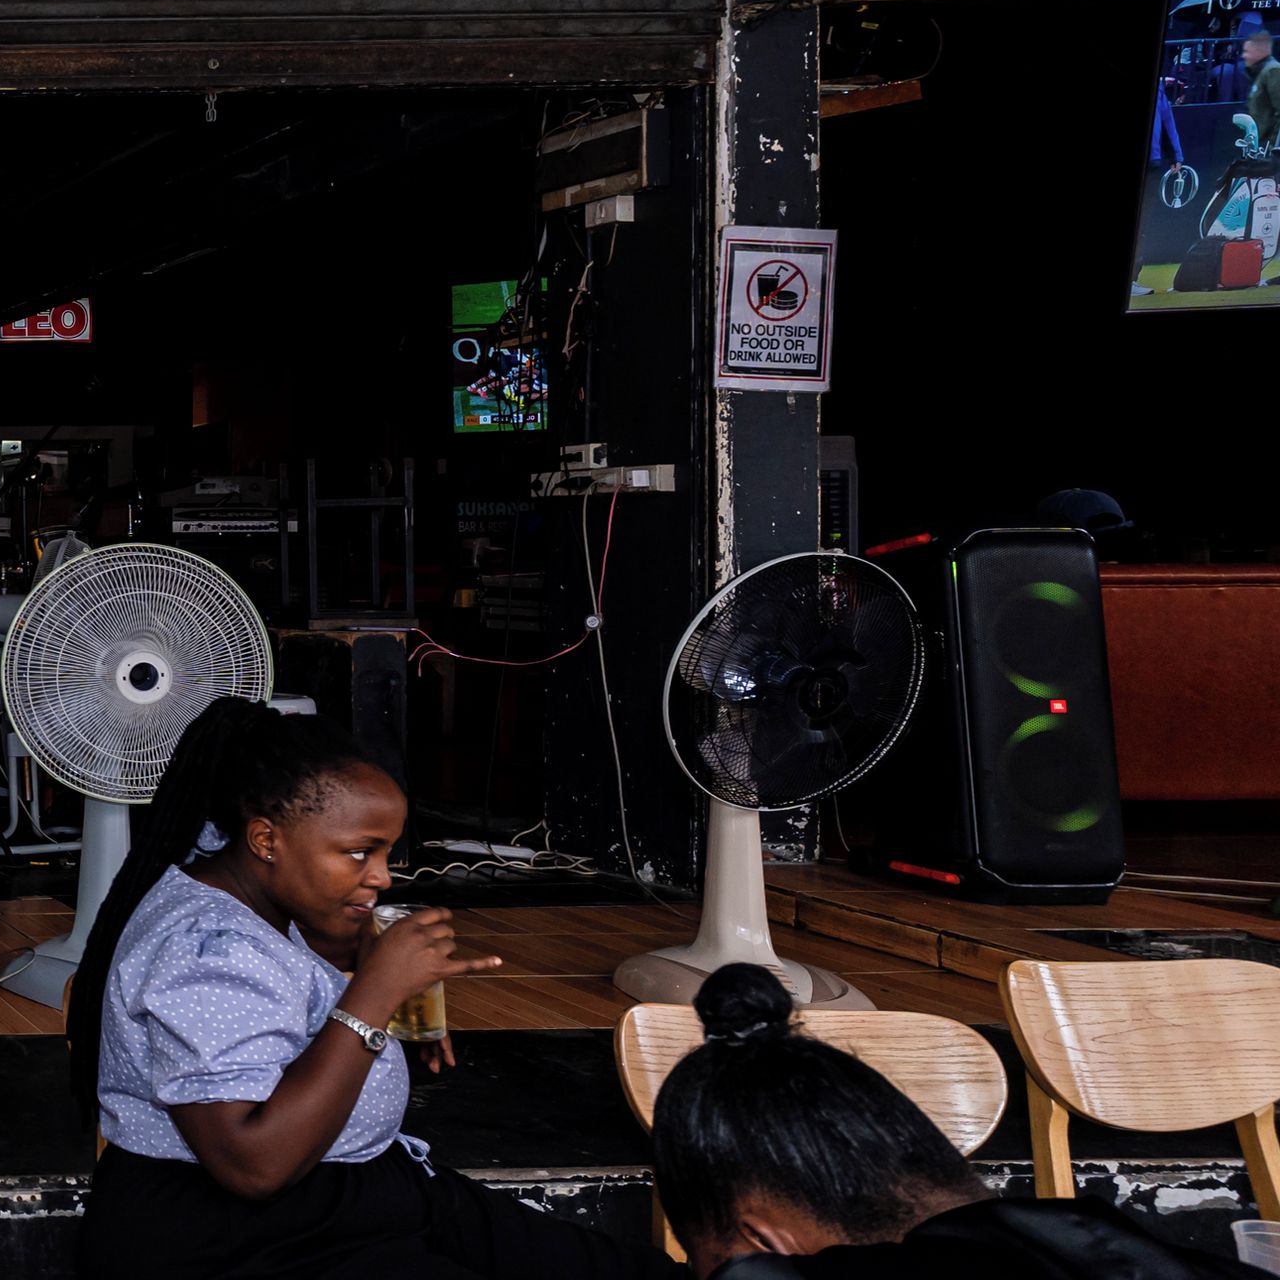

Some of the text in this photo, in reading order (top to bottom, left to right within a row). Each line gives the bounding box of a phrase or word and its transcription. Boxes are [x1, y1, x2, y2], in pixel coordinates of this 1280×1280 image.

[731, 323, 818, 339] NO OUTSIDE
[740, 337, 805, 351] FOOD OR
[729, 350, 817, 365] DRINK ALLOWED
